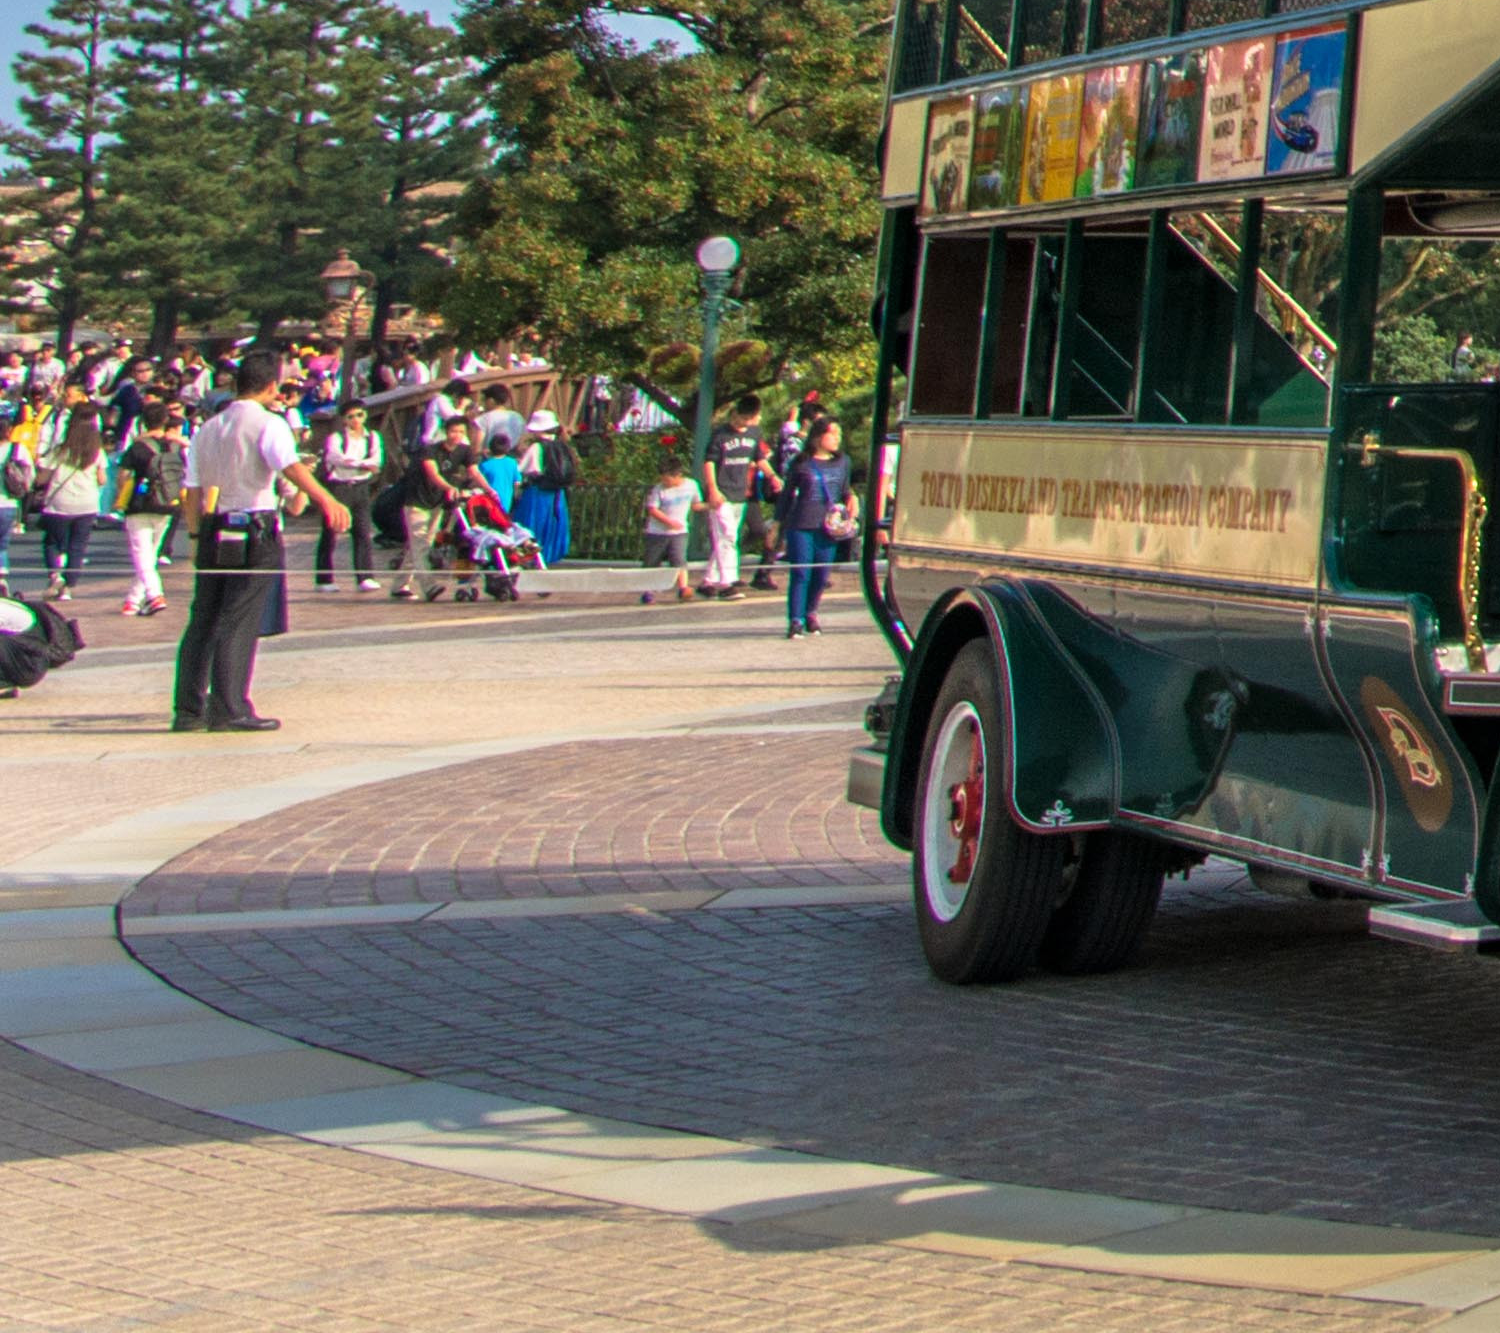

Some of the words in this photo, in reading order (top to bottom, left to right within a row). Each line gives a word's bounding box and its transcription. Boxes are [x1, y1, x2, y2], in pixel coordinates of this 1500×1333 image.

[920, 469, 963, 510] TOKYO
[965, 473, 1059, 516] DISNEYLAND
[1061, 478, 1203, 527] TRANSPORTATION
[1206, 485, 1292, 533] COMPANY
